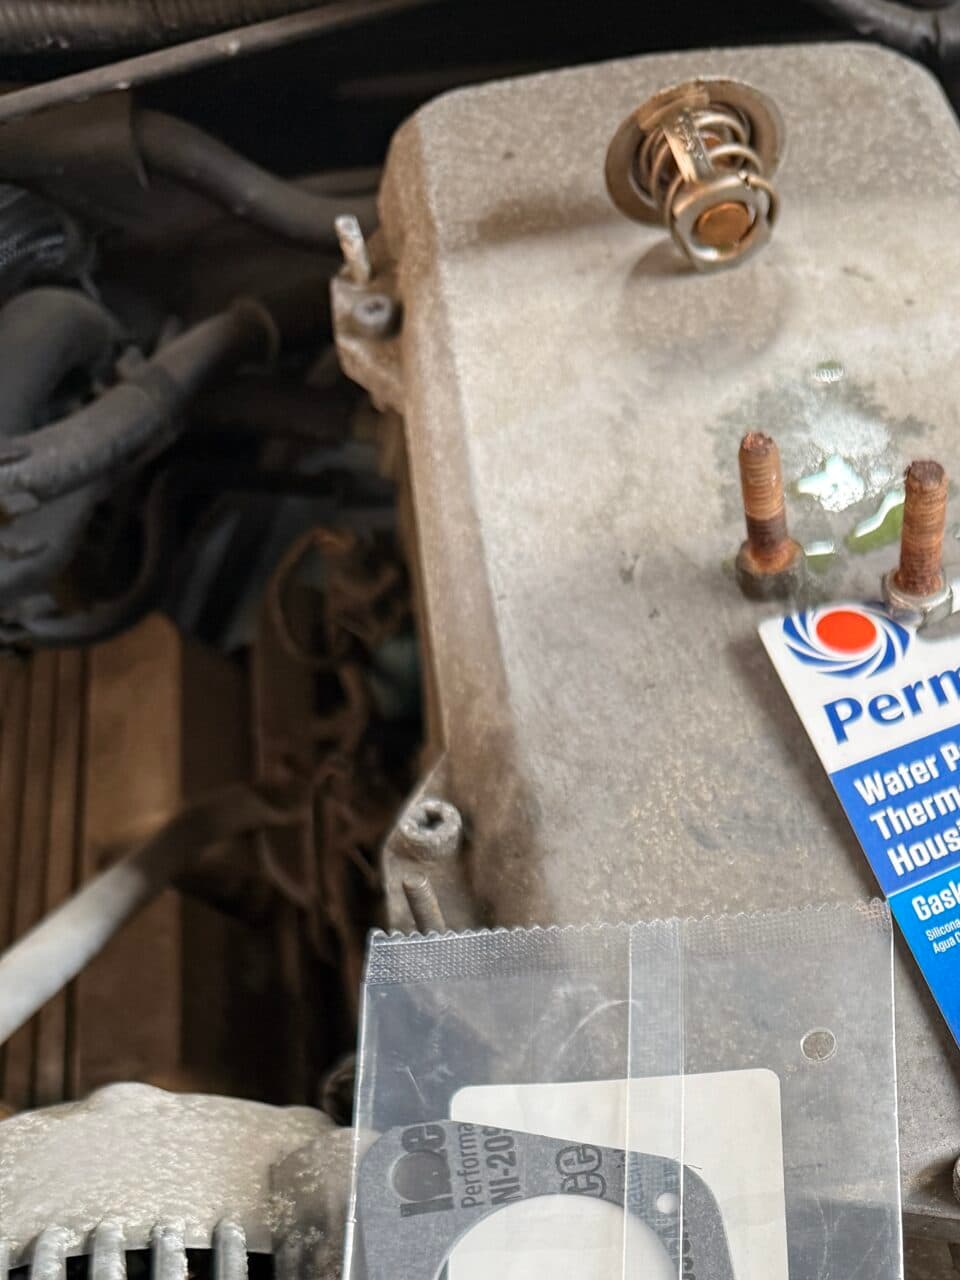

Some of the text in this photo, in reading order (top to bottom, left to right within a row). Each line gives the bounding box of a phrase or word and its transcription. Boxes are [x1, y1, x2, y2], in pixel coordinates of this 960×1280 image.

[853, 754, 940, 806] Water
[925, 917, 960, 941] Silicona
[932, 935, 956, 954] Agua
